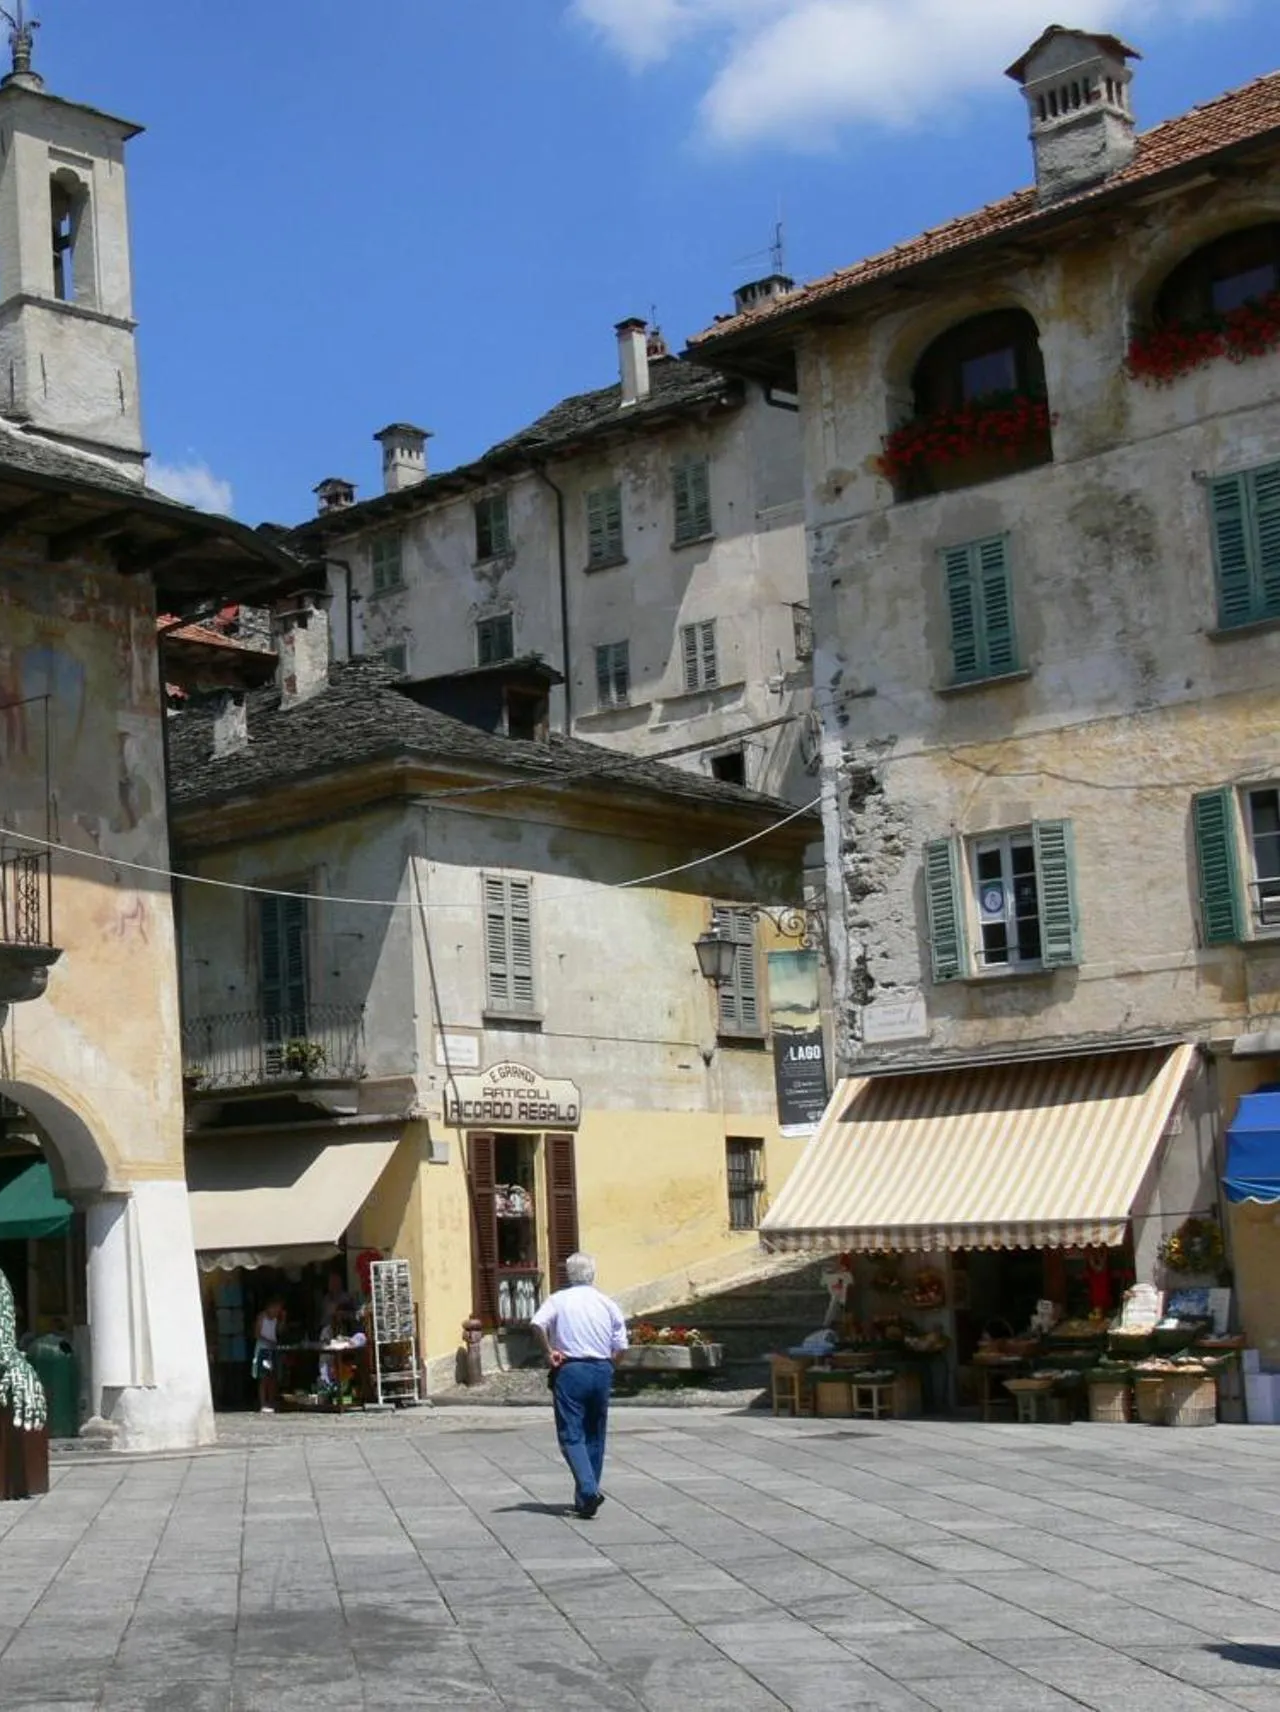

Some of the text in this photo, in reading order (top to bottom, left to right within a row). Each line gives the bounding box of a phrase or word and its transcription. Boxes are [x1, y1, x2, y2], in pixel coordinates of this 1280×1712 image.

[789, 1045, 821, 1060] LAGO
[483, 1087, 549, 1099] ARTICOLI
[450, 1101, 577, 1120] RICORDO REGALO
